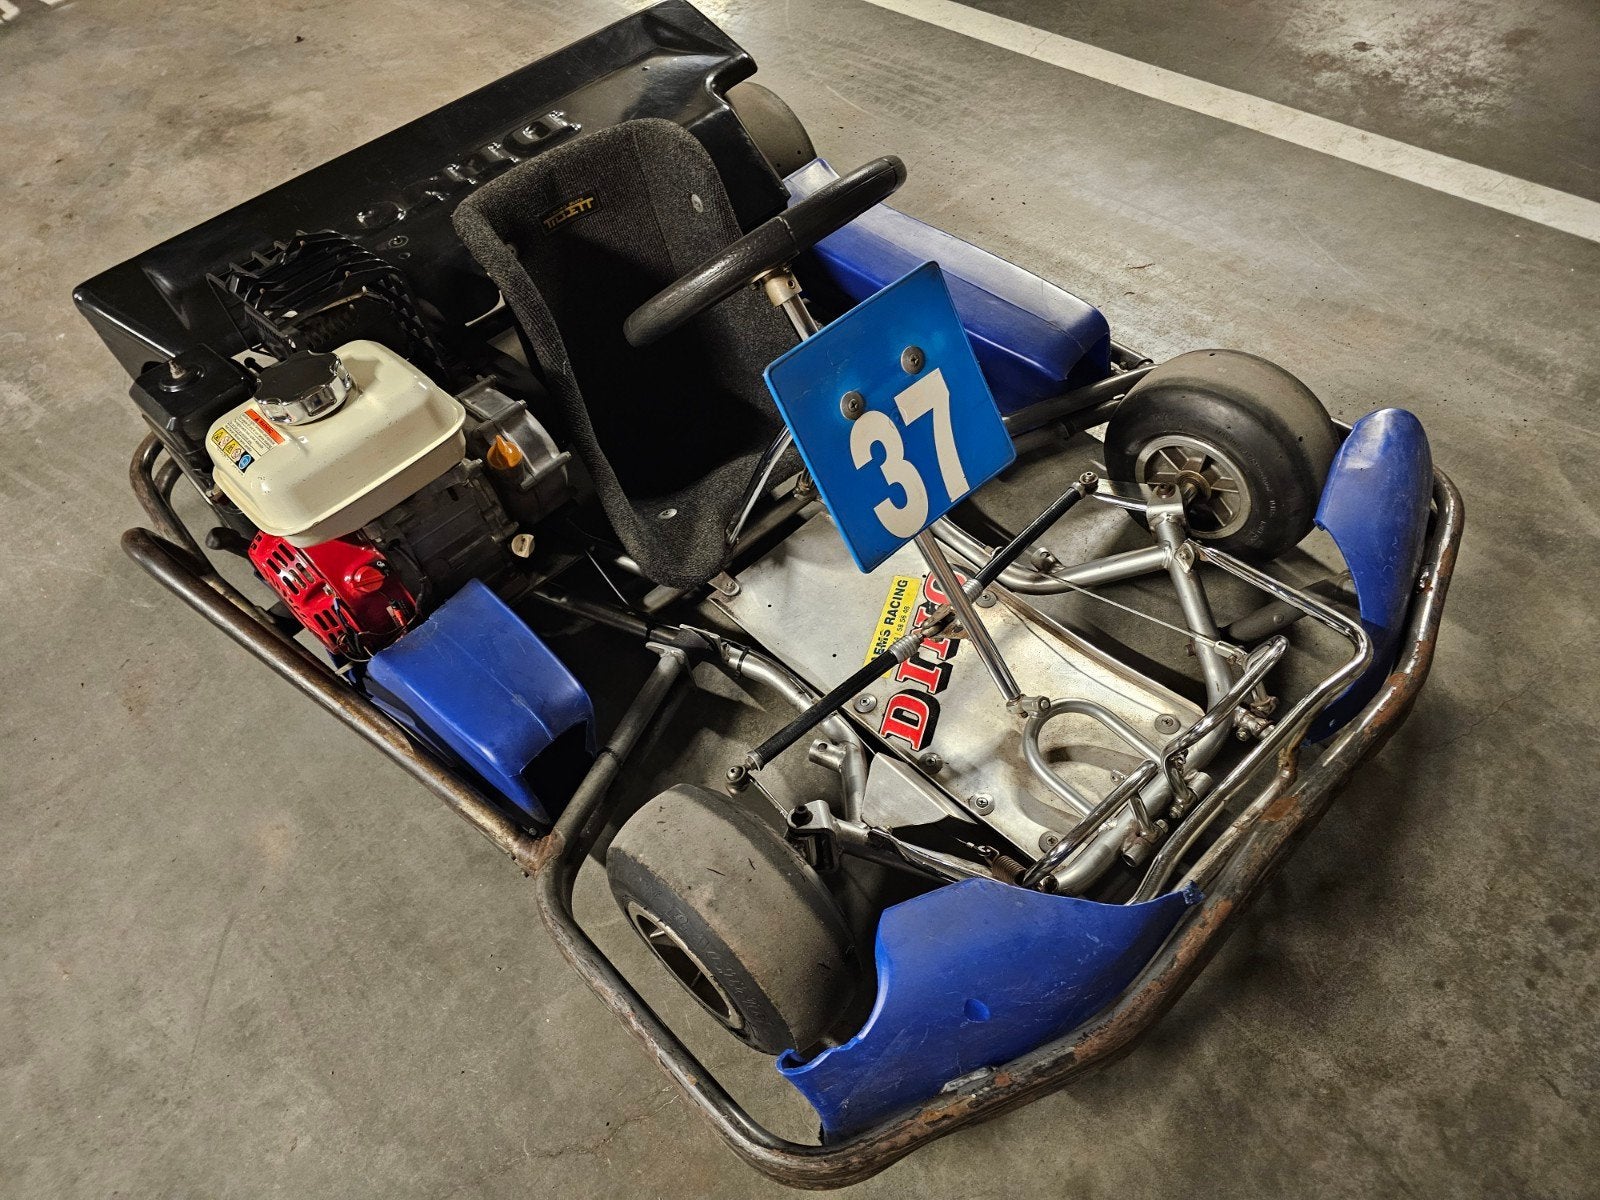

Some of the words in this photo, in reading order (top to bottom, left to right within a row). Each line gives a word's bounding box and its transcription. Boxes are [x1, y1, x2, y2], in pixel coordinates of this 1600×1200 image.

[850, 367, 971, 538] 37
[871, 629, 891, 660] EMS
[884, 579, 908, 625] RACING
